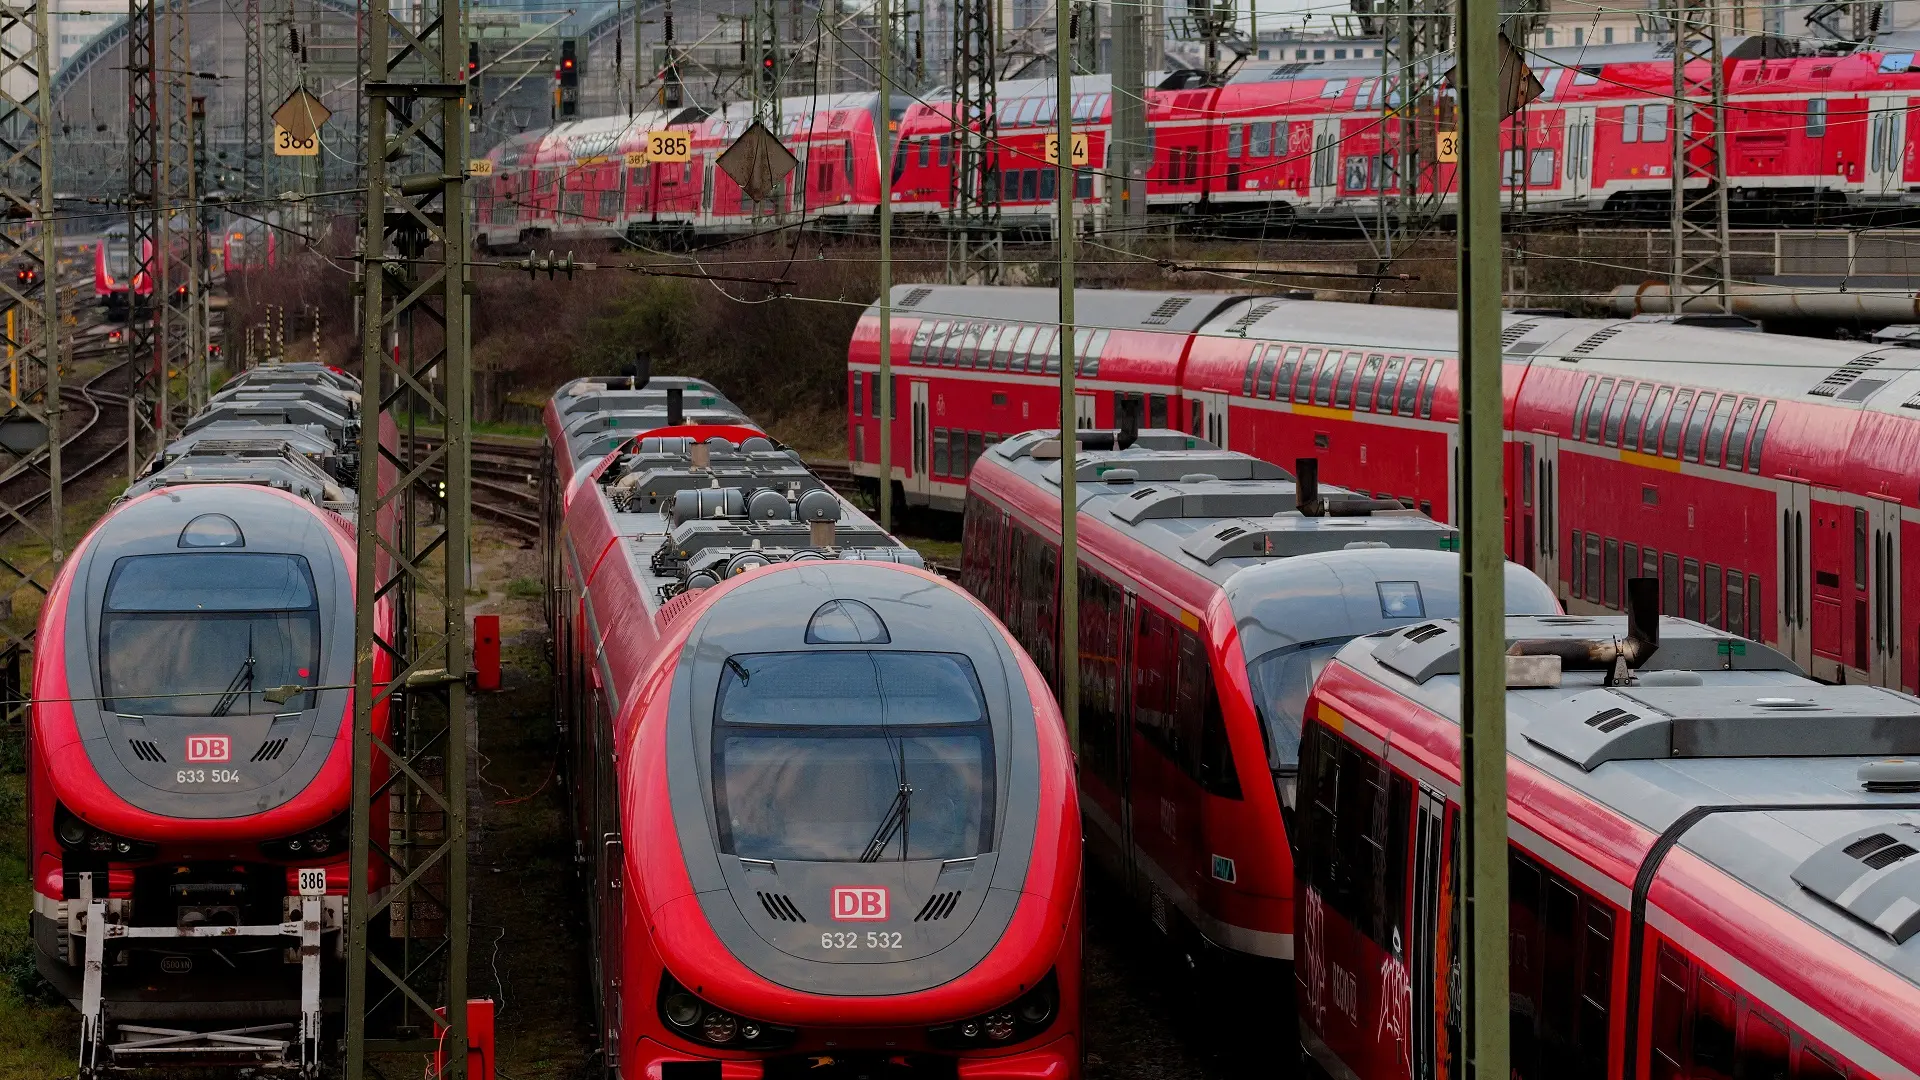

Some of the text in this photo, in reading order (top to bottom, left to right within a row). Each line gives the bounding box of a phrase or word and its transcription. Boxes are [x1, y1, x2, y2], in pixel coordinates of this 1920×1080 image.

[652, 138, 687, 155] 385
[1050, 141, 1084, 158] 34
[473, 163, 490, 172] 382
[190, 738, 227, 759] DB
[176, 769, 240, 783] 633 504
[301, 872, 323, 889] 386
[837, 890, 884, 917] DB
[821, 932, 903, 949] 632 532
